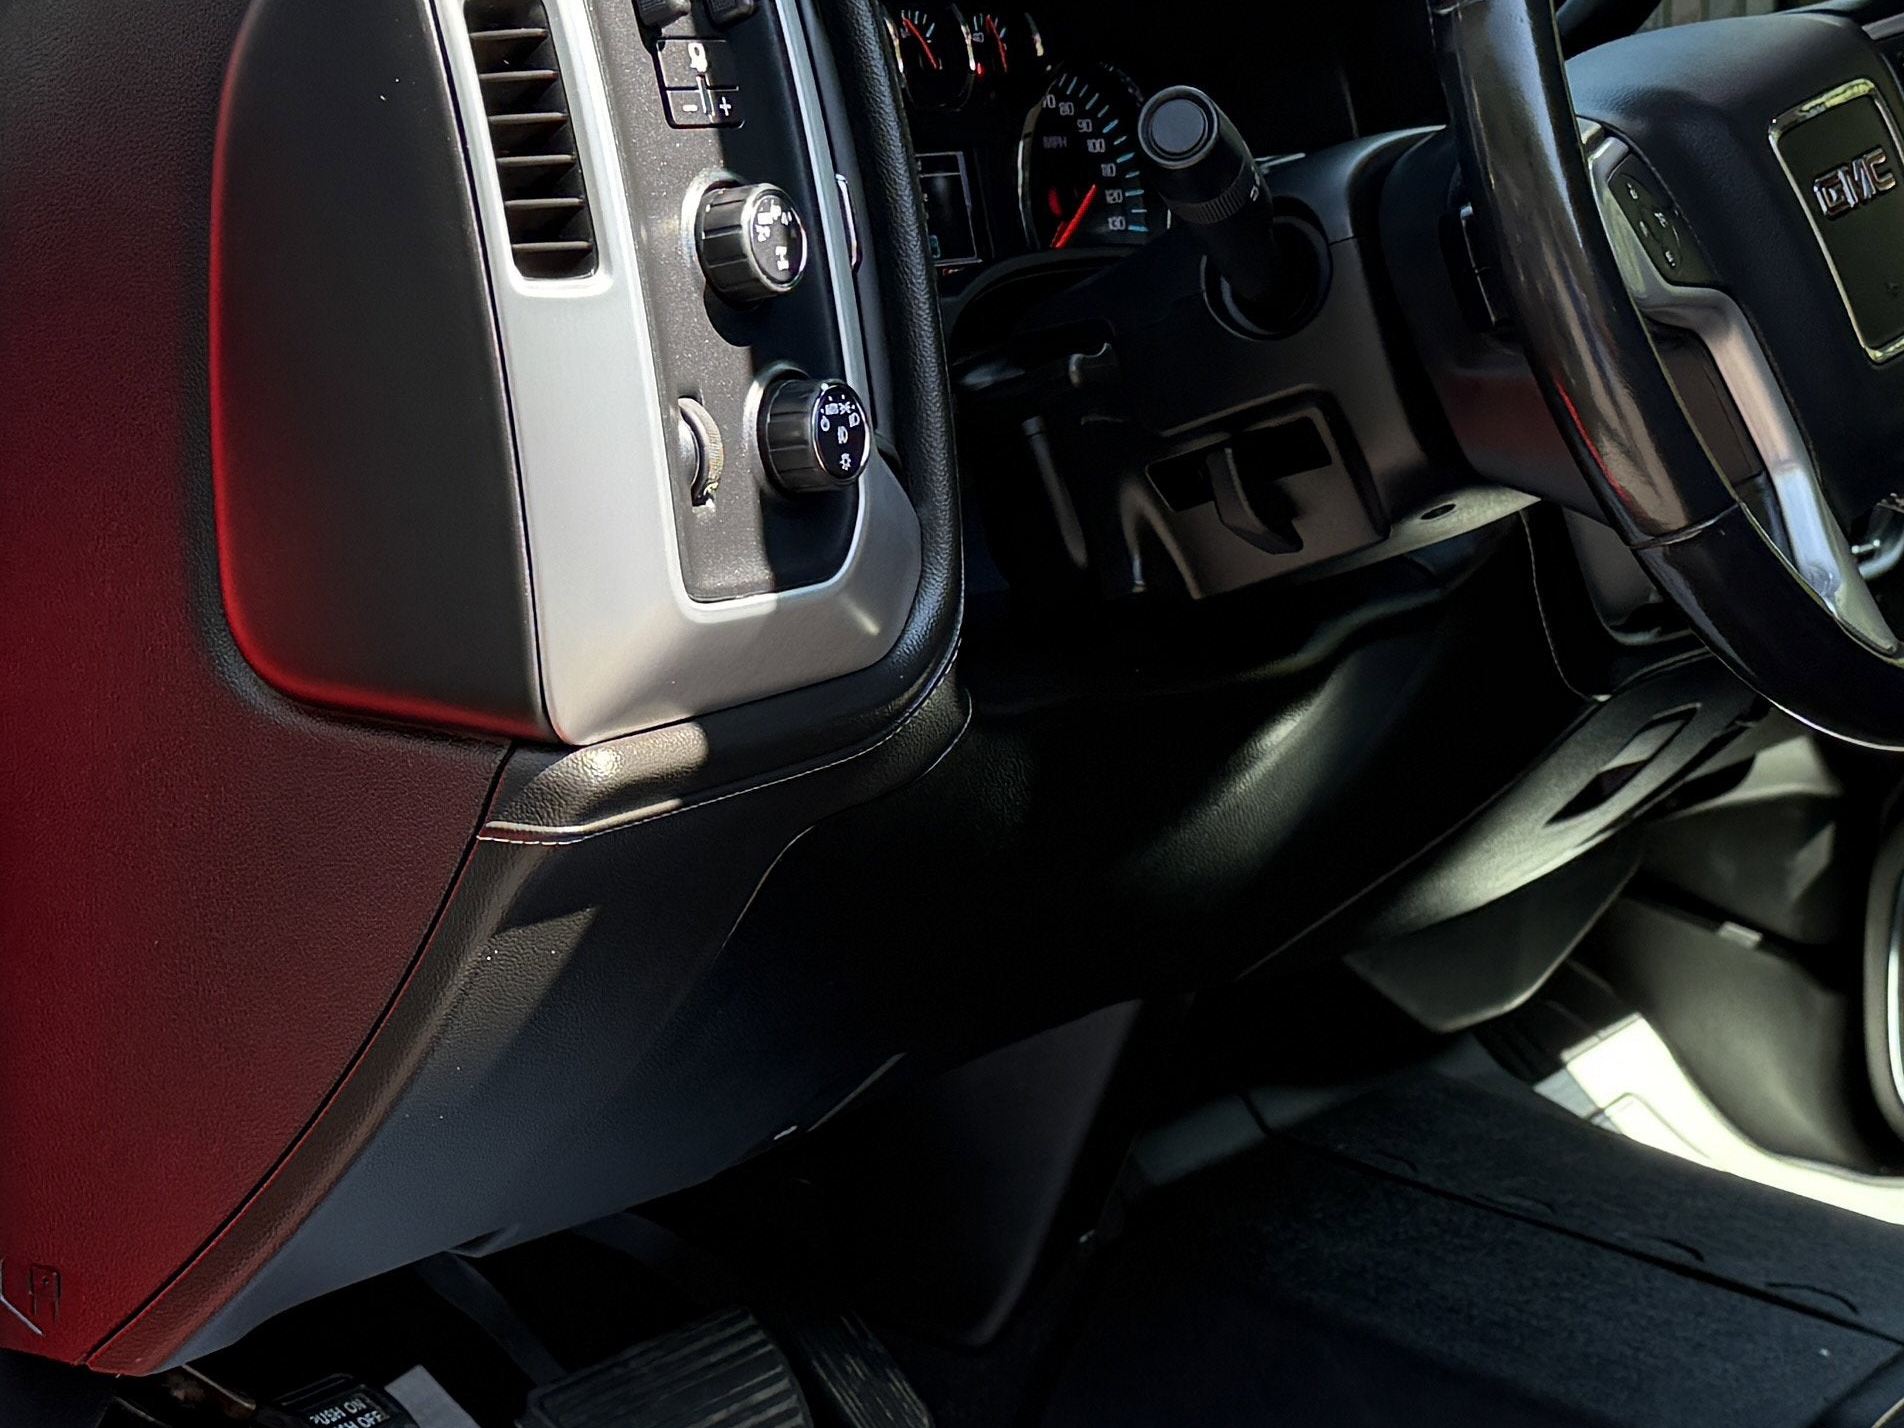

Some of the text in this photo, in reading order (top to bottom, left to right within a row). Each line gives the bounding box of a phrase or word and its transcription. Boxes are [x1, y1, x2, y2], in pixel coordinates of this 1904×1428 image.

[1077, 118, 1092, 133] 90
[1086, 138, 1106, 153] 100
[1813, 147, 1896, 217] GMC
[1105, 188, 1123, 204] 120
[1107, 216, 1126, 231] 130
[343, 1398, 367, 1414] ON
